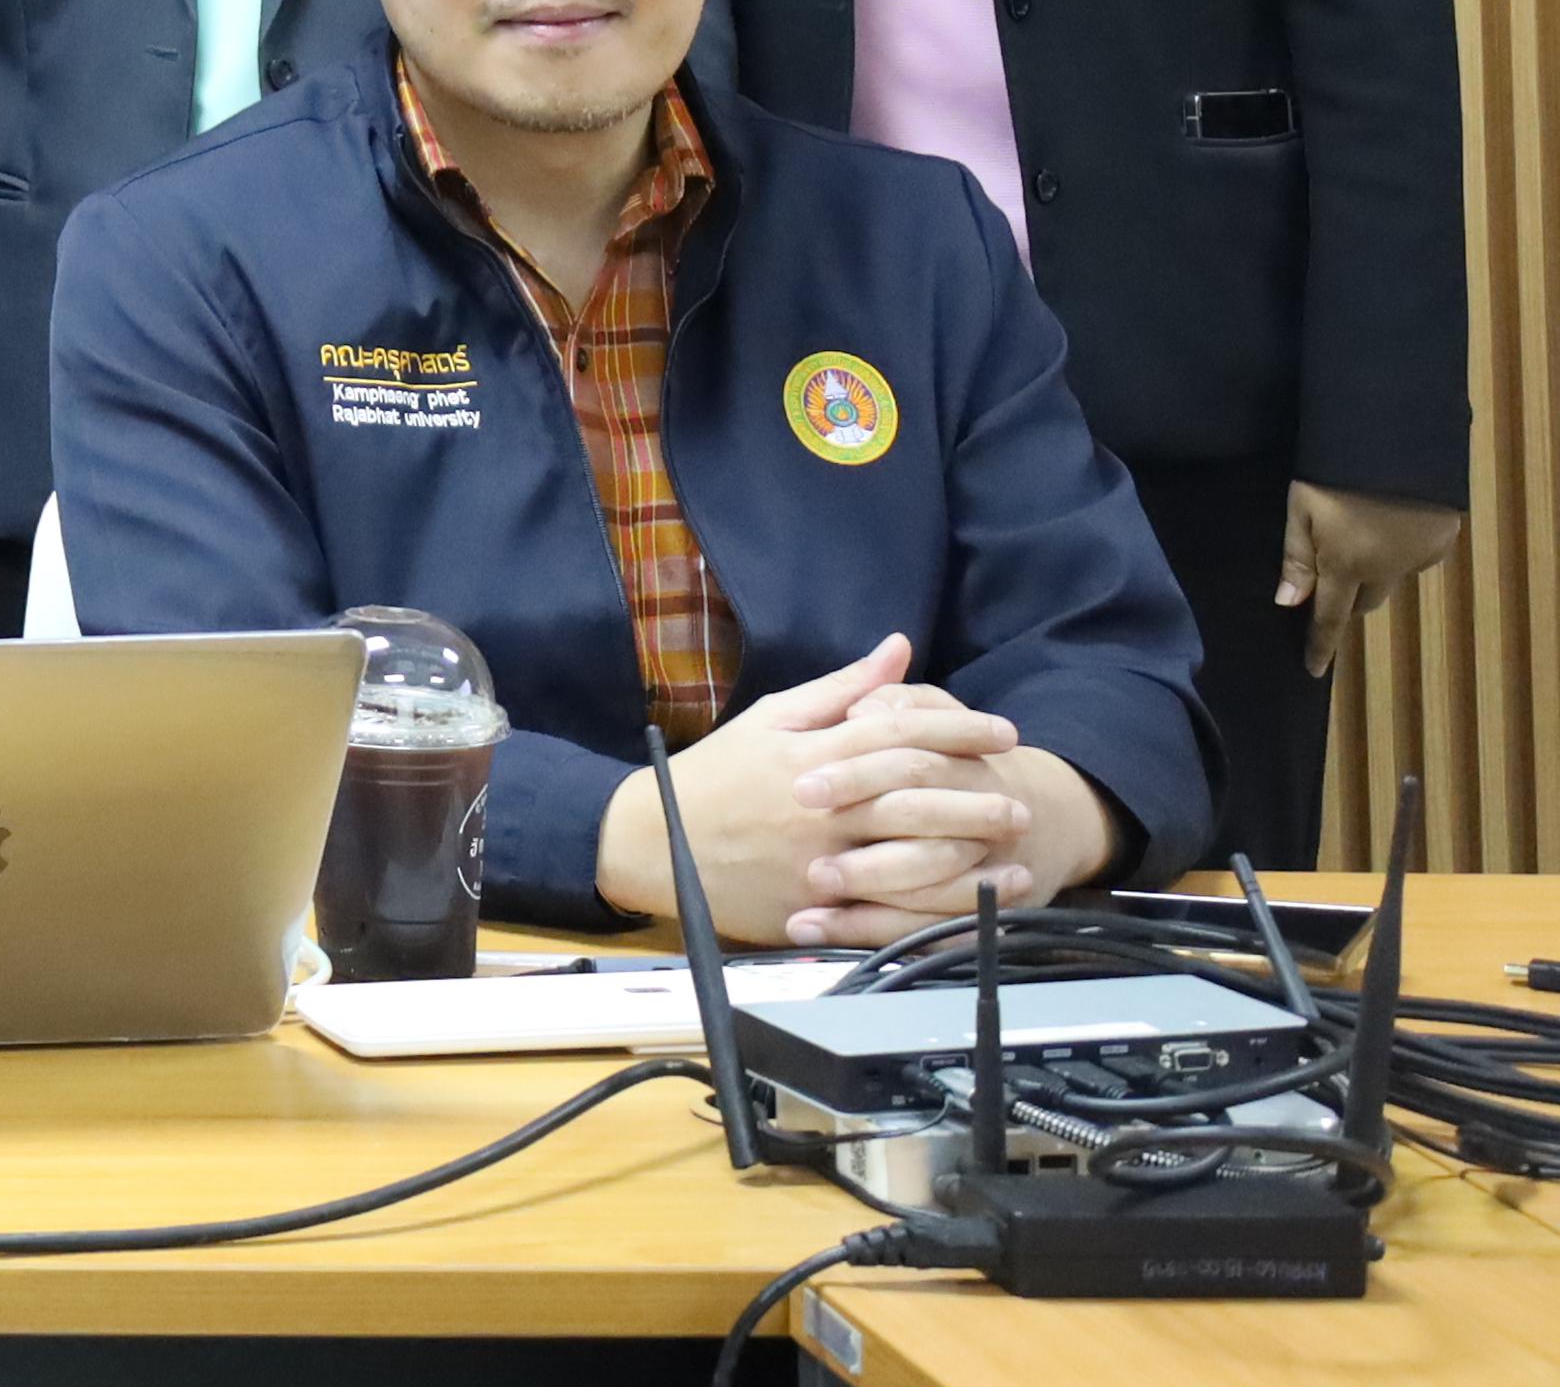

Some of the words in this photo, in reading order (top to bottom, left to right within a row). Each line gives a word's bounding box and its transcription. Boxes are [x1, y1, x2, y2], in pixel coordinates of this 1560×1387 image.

[320, 344, 471, 381] คณะครุศาสตร์
[427, 388, 470, 410] phet
[332, 404, 401, 426] Rajabhat
[404, 410, 480, 429] university
